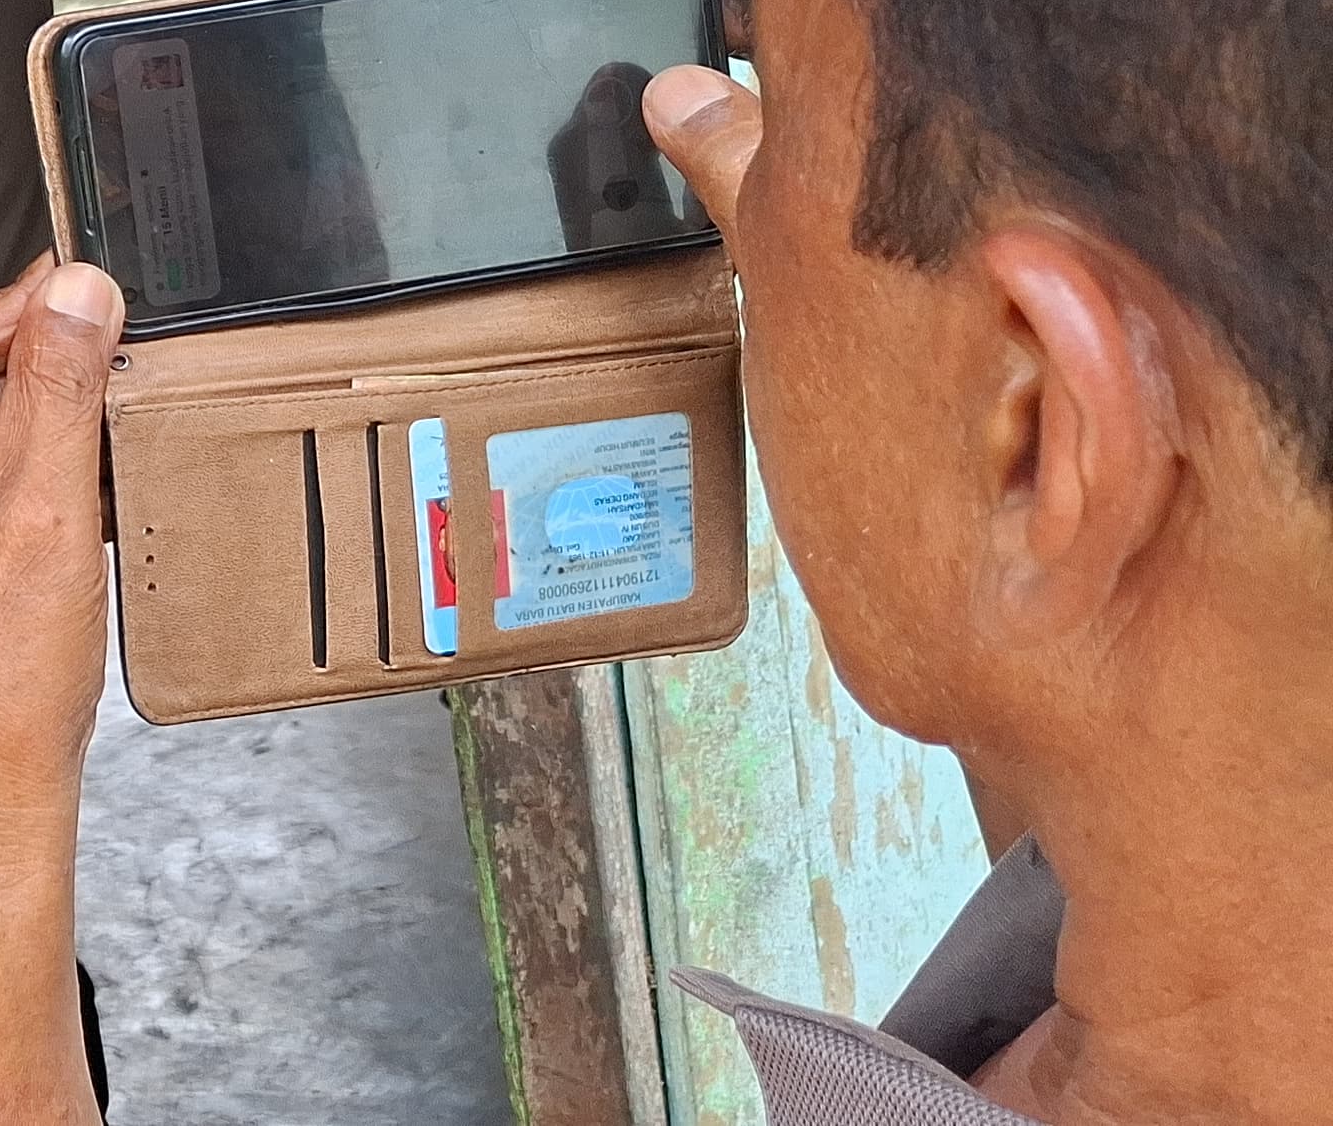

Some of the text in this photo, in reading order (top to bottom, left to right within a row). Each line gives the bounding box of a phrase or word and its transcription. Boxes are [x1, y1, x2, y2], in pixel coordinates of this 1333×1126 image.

[515, 592, 641, 622] KABUPATEN BATU BARA
